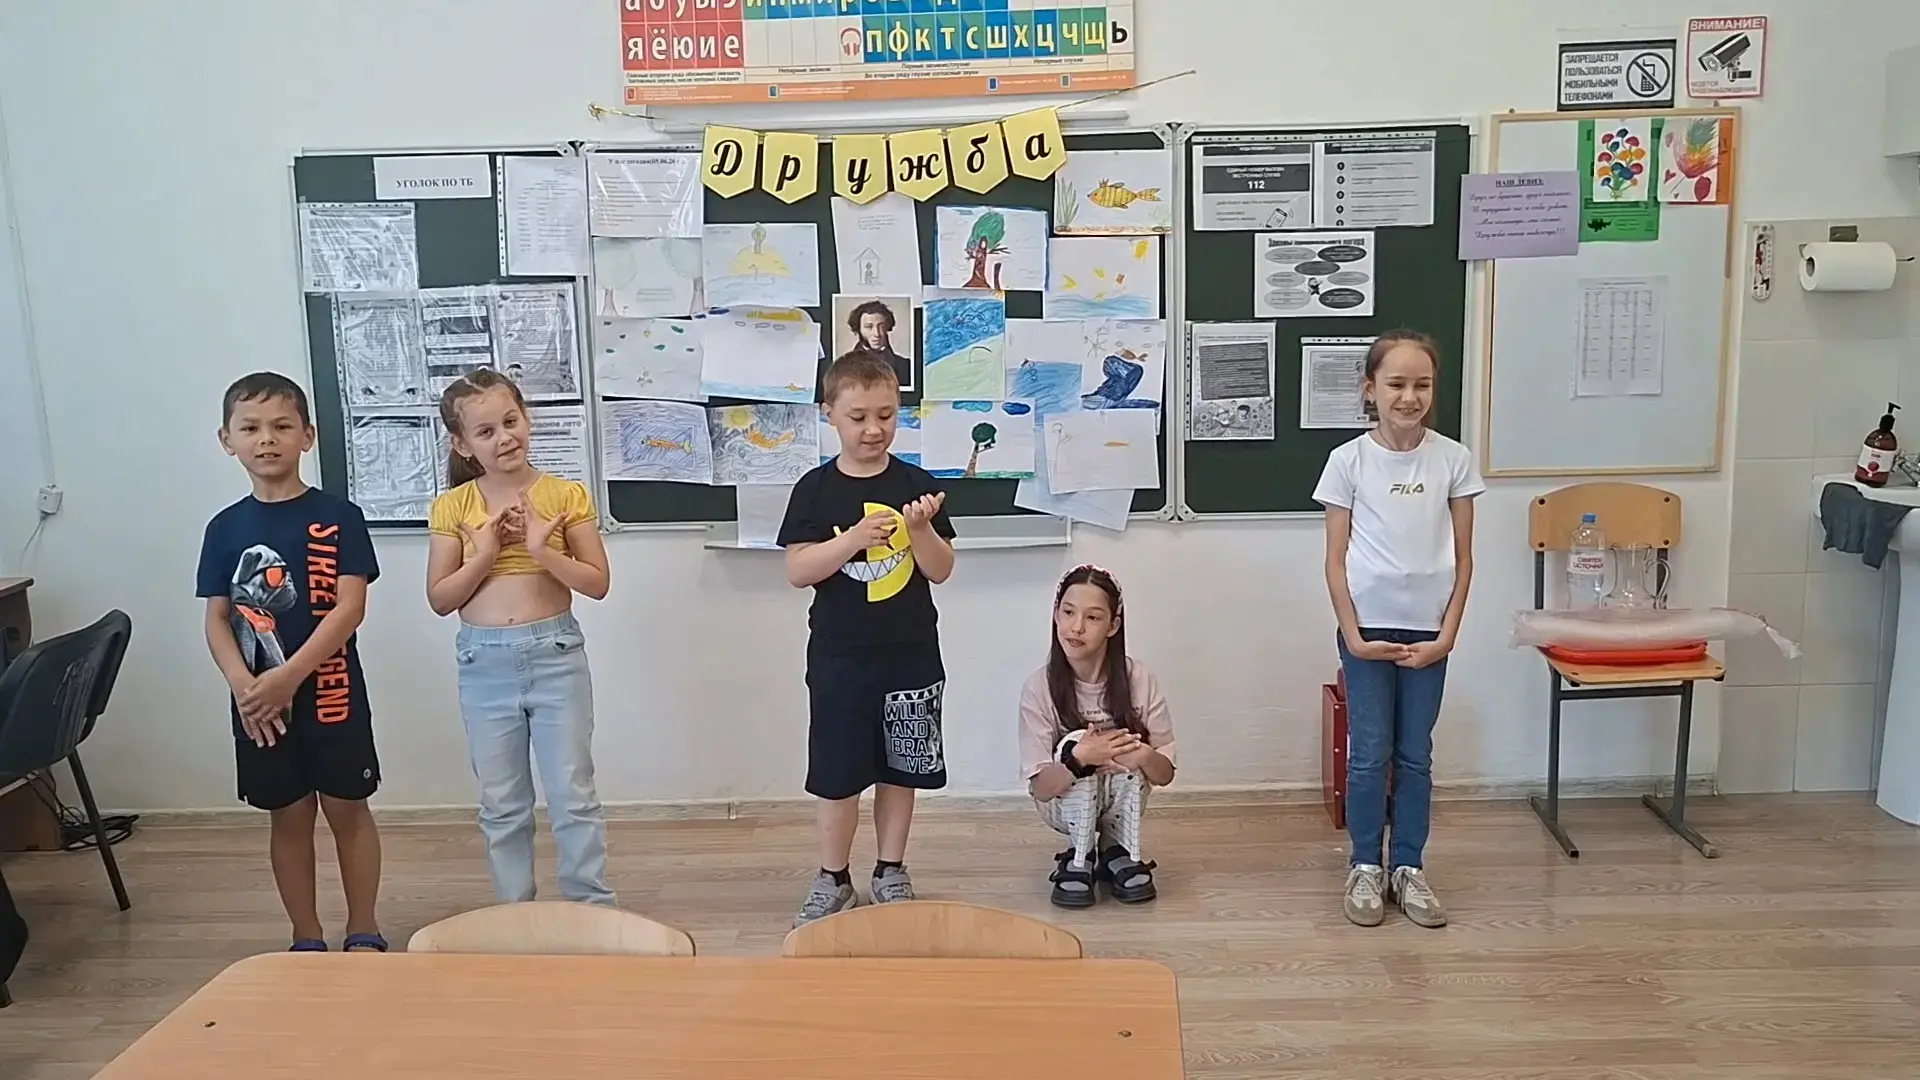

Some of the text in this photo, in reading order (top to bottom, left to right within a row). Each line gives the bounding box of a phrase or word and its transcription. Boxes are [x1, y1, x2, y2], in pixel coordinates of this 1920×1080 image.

[1690, 18, 1765, 30] ВНИМАНИЕ!
[1565, 53, 1619, 63] ЗАПРЕЩАЕТСЯ
[1565, 66, 1622, 76] ПОЛЬЗОВАТЬСЯ
[1565, 79, 1619, 88] МОБИЛЬНЫМИ
[1565, 92, 1614, 101] ТЕЛЕФОНАМИ
[396, 177, 474, 189] УГОЛОК ПО ТБ
[1247, 180, 1265, 189] 112
[1389, 483, 1425, 495] FILA
[316, 647, 350, 725] GEND
[884, 701, 928, 721] WILD
[891, 720, 928, 738] AND
[891, 738, 929, 756] BRA
